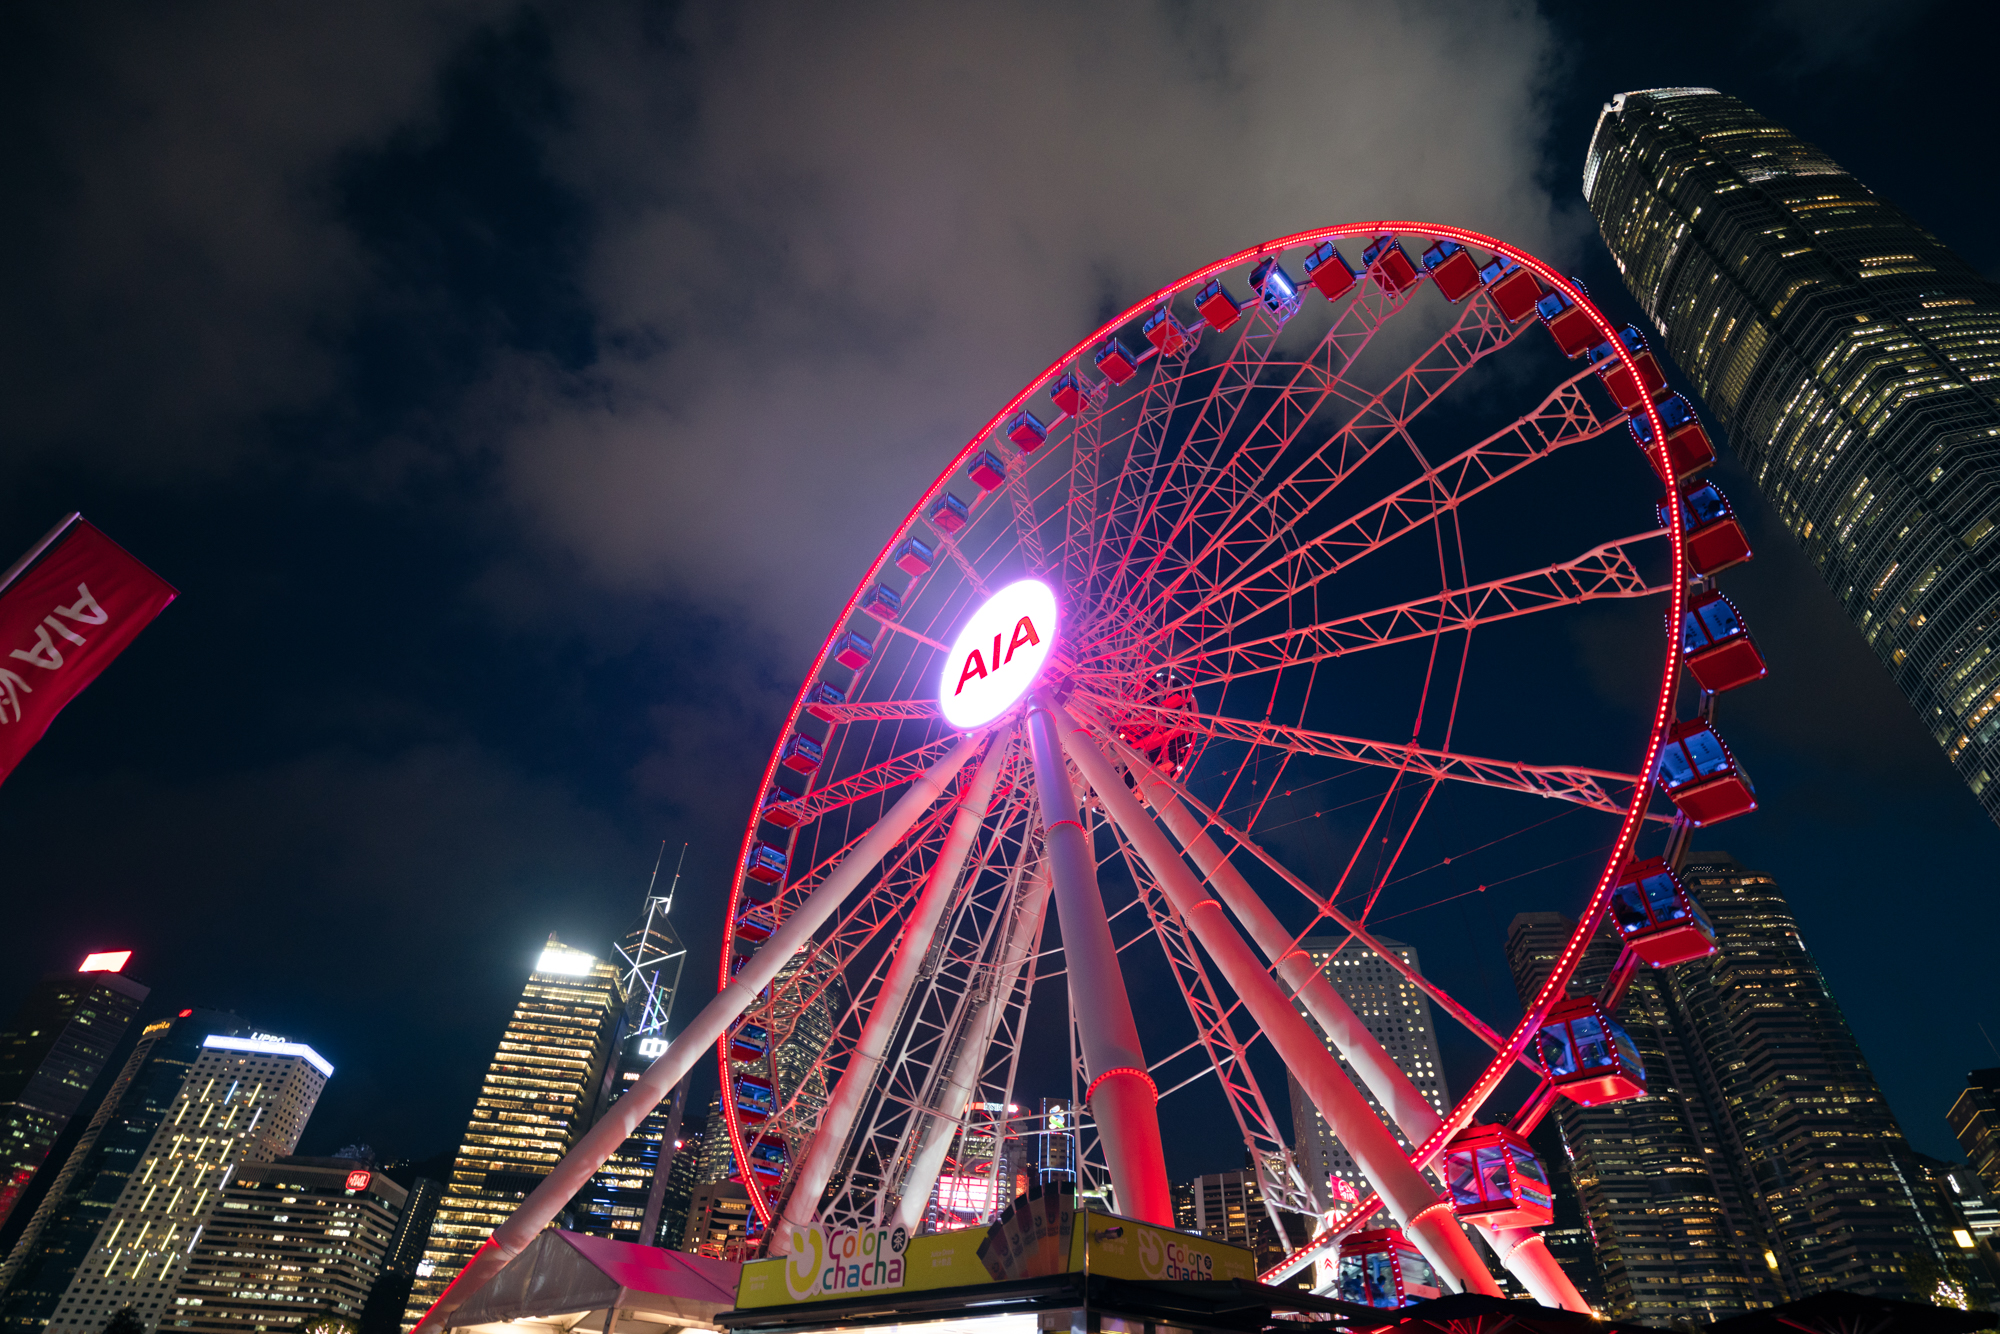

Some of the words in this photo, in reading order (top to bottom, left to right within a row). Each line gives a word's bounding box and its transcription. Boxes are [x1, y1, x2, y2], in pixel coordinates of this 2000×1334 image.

[9, 582, 108, 670] AIA
[954, 615, 1040, 697] AIA
[829, 1226, 887, 1260] Color
[892, 1230, 906, 1251] 茶
[1167, 1243, 1202, 1266] Color
[822, 1255, 902, 1290] chacha
